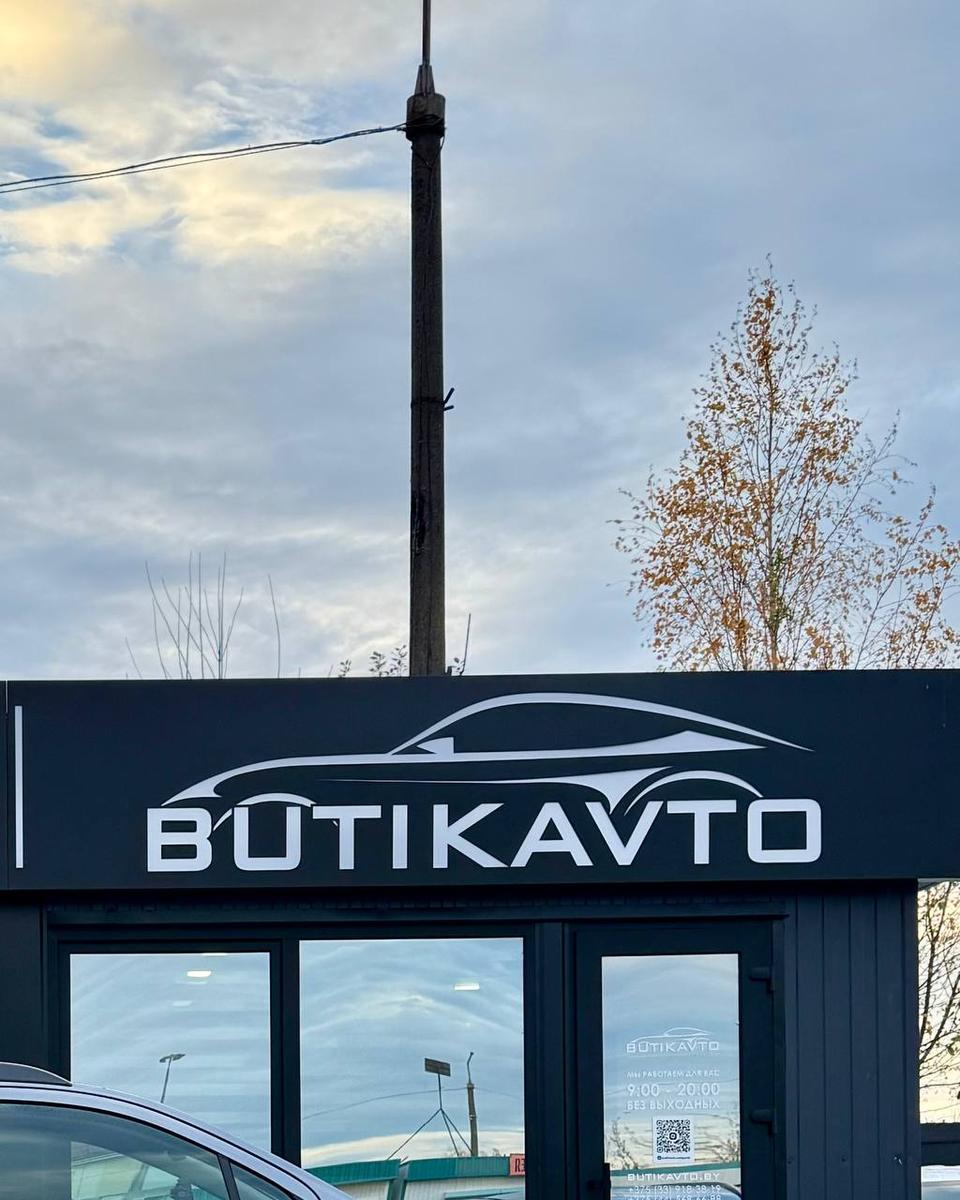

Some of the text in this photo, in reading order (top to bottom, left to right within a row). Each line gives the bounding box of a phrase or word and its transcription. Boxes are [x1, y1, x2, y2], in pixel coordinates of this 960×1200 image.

[147, 798, 822, 873] BUTIKAVTO
[626, 1041, 720, 1053] BUTIKAVTO
[627, 1084, 660, 1097] 9:00
[678, 1083, 720, 1096] 20:00
[627, 1099, 720, 1111] БЕЗ ВЫХОДНЫХ
[627, 1172, 720, 1182] BUTIKAVTO.BY
